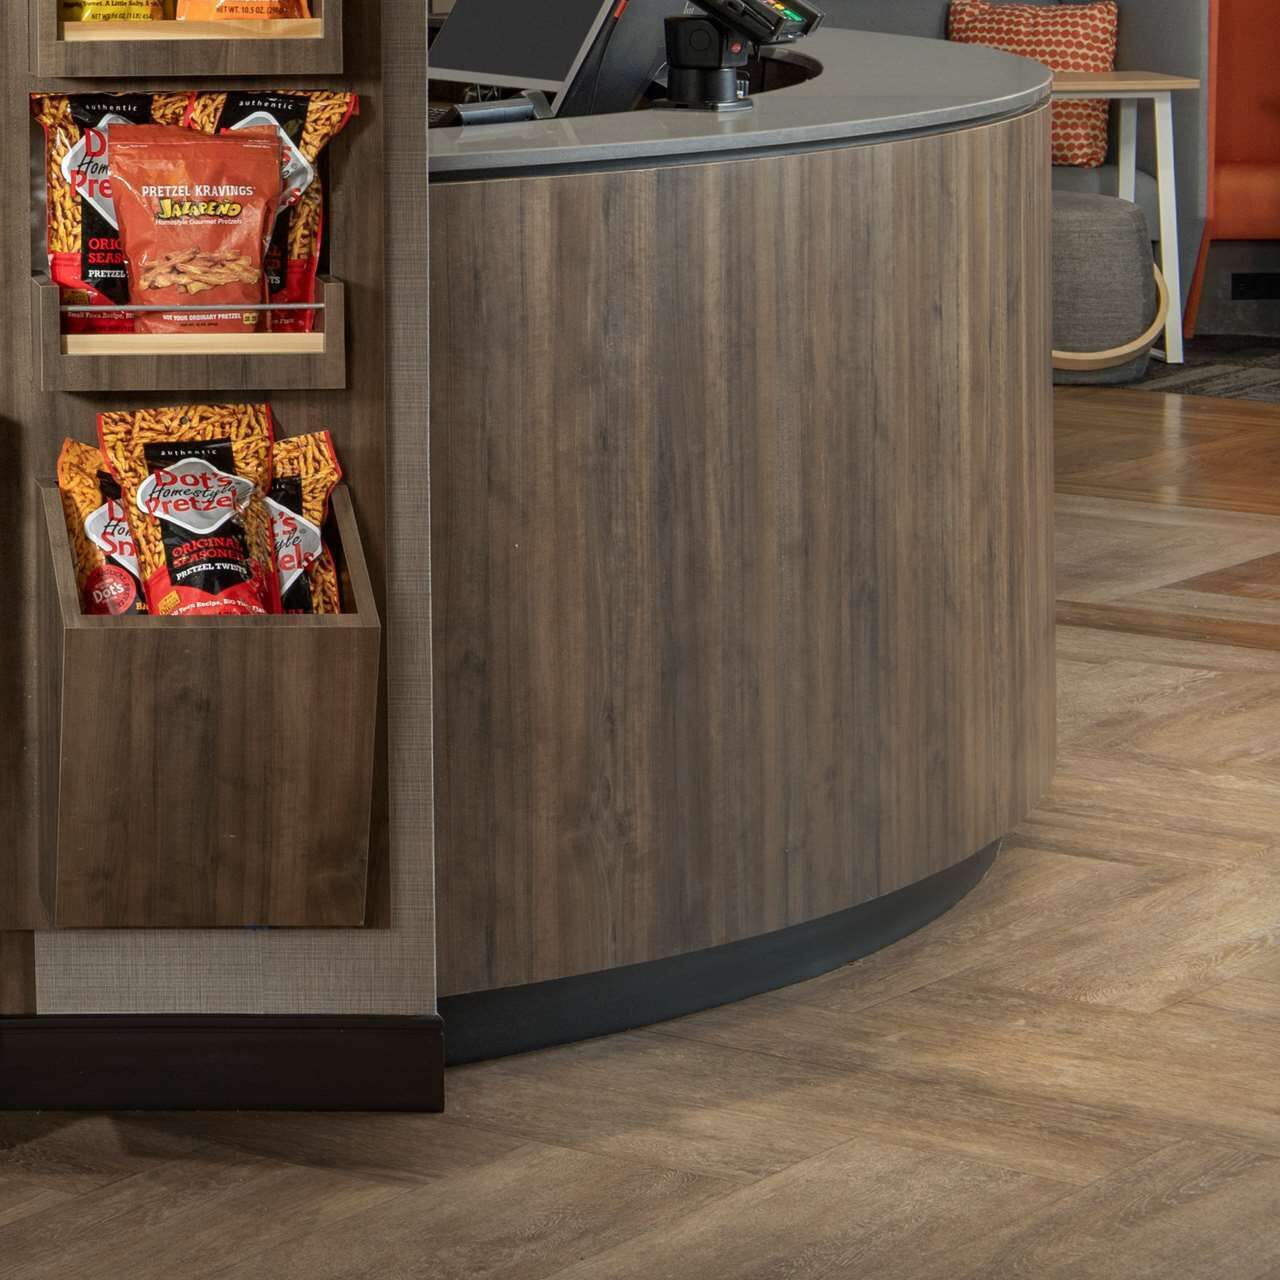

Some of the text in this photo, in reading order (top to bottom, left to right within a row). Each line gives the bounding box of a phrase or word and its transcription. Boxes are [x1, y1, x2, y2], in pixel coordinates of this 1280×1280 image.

[84, 103, 138, 113] authentic
[239, 99, 294, 110] authentic
[142, 185, 254, 197] PRETZEL KRAVINGS
[87, 269, 126, 280] PRETZEL
[154, 468, 234, 489] Dot's
[176, 563, 214, 581] PRETZEL
